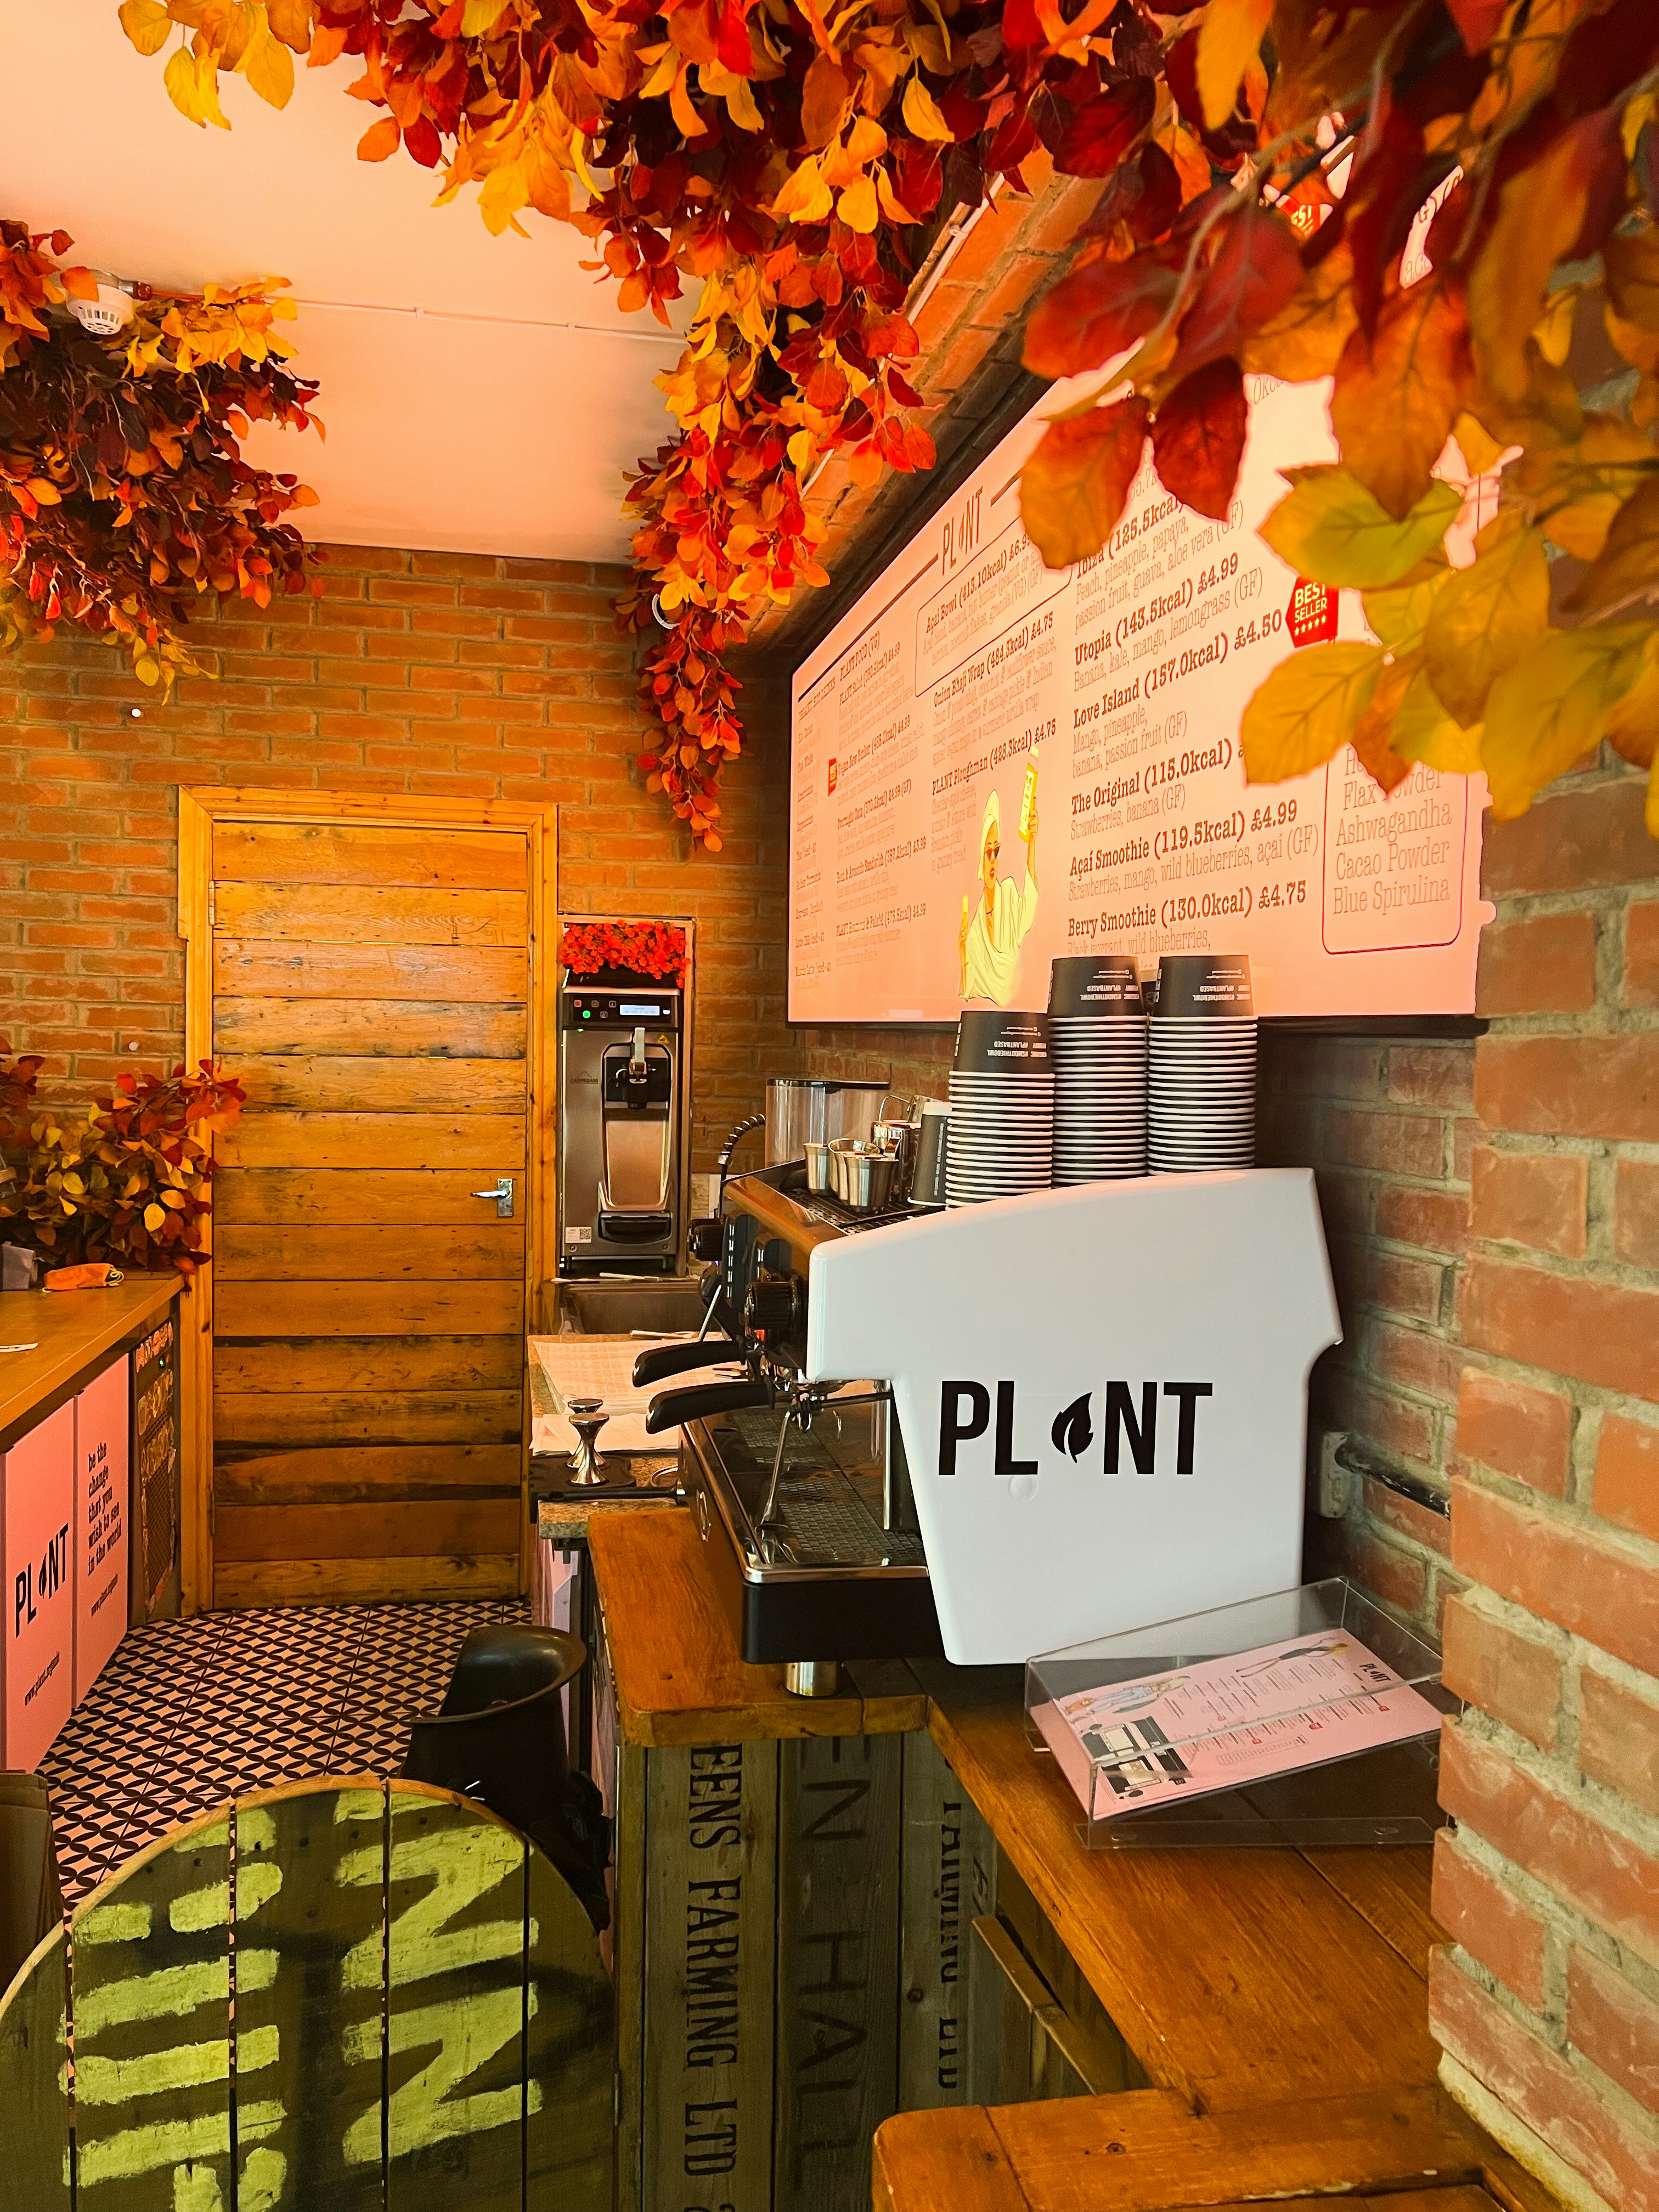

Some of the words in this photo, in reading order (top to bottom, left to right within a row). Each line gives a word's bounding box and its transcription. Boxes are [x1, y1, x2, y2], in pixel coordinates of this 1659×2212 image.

[942, 486, 983, 576] PLANT
[1022, 555, 1029, 573] or
[1075, 597, 1105, 635] passion
[1108, 579, 1130, 610] fruit,
[1133, 561, 1164, 597] guava,
[1167, 542, 1187, 571] aloe
[1190, 526, 1214, 555] vera
[1076, 571, 1102, 605] Peach,
[1104, 540, 1149, 591] pineapple,
[1153, 516, 1188, 559] papaya,
[940, 593, 957, 620] Bowl
[1074, 629, 1111, 665] Utopia
[1115, 578, 1193, 647] (143.5kcal)
[1198, 552, 1238, 594] £4.99
[1295, 584, 1327, 609] BEST
[1295, 602, 1327, 622] SELLER
[967, 662, 984, 684] Wrap
[1030, 611, 1053, 640] £4.75
[1074, 662, 1106, 692] Banana,
[1109, 645, 1129, 673] kale,
[1132, 629, 1166, 661] mango,
[1170, 590, 1230, 640] lemongrass
[1234, 566, 1262, 608] (GF)
[982, 697, 987, 716] &
[1025, 668, 1031, 689] &
[1032, 661, 1052, 685] Indian
[1000, 664, 1005, 684] &
[1036, 636, 1056, 661] sauce,
[1073, 703, 1099, 729] Love
[1102, 677, 1139, 715] Island
[1144, 632, 1228, 698] (157.0kcal)
[1234, 608, 1282, 650] £4.50
[1025, 692, 1039, 712] wrap
[1073, 729, 1101, 754] Mango,
[1103, 704, 1147, 746] pineapple,
[932, 771, 952, 795] PLANT
[1034, 718, 1056, 744] £4.75
[1073, 754, 1102, 778] banana,
[1105, 737, 1138, 771] passion
[1141, 724, 1161, 751] fruit
[1164, 710, 1187, 744] (GF)
[1071, 793, 1091, 815] The
[1093, 771, 1139, 807] Original
[1144, 737, 1232, 794] (115.0kcal)
[1342, 775, 1377, 810] Flax
[1069, 850, 1093, 881] Açaí
[1095, 837, 1149, 870] Smoothie
[1154, 810, 1245, 860] (119.5kcal)
[1250, 799, 1297, 832] £4.99
[1070, 810, 1122, 840] Strawberries,
[1126, 797, 1159, 822] banana
[1162, 783, 1185, 815] (GF)
[1335, 798, 1452, 847] Ashwagandha
[1069, 876, 1120, 901] Strawberries,
[1124, 867, 1156, 890] mango,
[1160, 856, 1182, 882] wild
[1185, 847, 1252, 877] blueberries,
[1257, 832, 1282, 866] açaí
[1287, 823, 1318, 860] (GF)
[1336, 852, 1381, 880] Cacao
[1387, 836, 1449, 872] Powder
[1068, 917, 1097, 939] Berry
[1101, 902, 1155, 932] Smoothie
[1161, 885, 1252, 929] (130.0kcal)
[1259, 879, 1306, 909] £4.75
[1333, 886, 1367, 914] Blue
[1373, 874, 1450, 916] Spirulina
[1127, 932, 1146, 955] wild
[1149, 928, 1210, 952] blueberries,
[88, 1453, 95, 1472] be
[97, 1441, 107, 1465] the
[938, 1381, 1212, 1476] PLANT
[88, 1465, 108, 1498] change
[88, 1500, 101, 1524] that
[103, 1486, 112, 1511] you
[88, 1526, 102, 1549] wish
[104, 1513, 110, 1531] to
[111, 1502, 120, 1523] see
[88, 1555, 94, 1577] in
[95, 1544, 105, 1568] the
[106, 1520, 122, 1554] world
[15, 1522, 69, 1638] PLANT
[685, 1880, 741, 2068] FARMING
[684, 2098, 737, 2176] LTD
